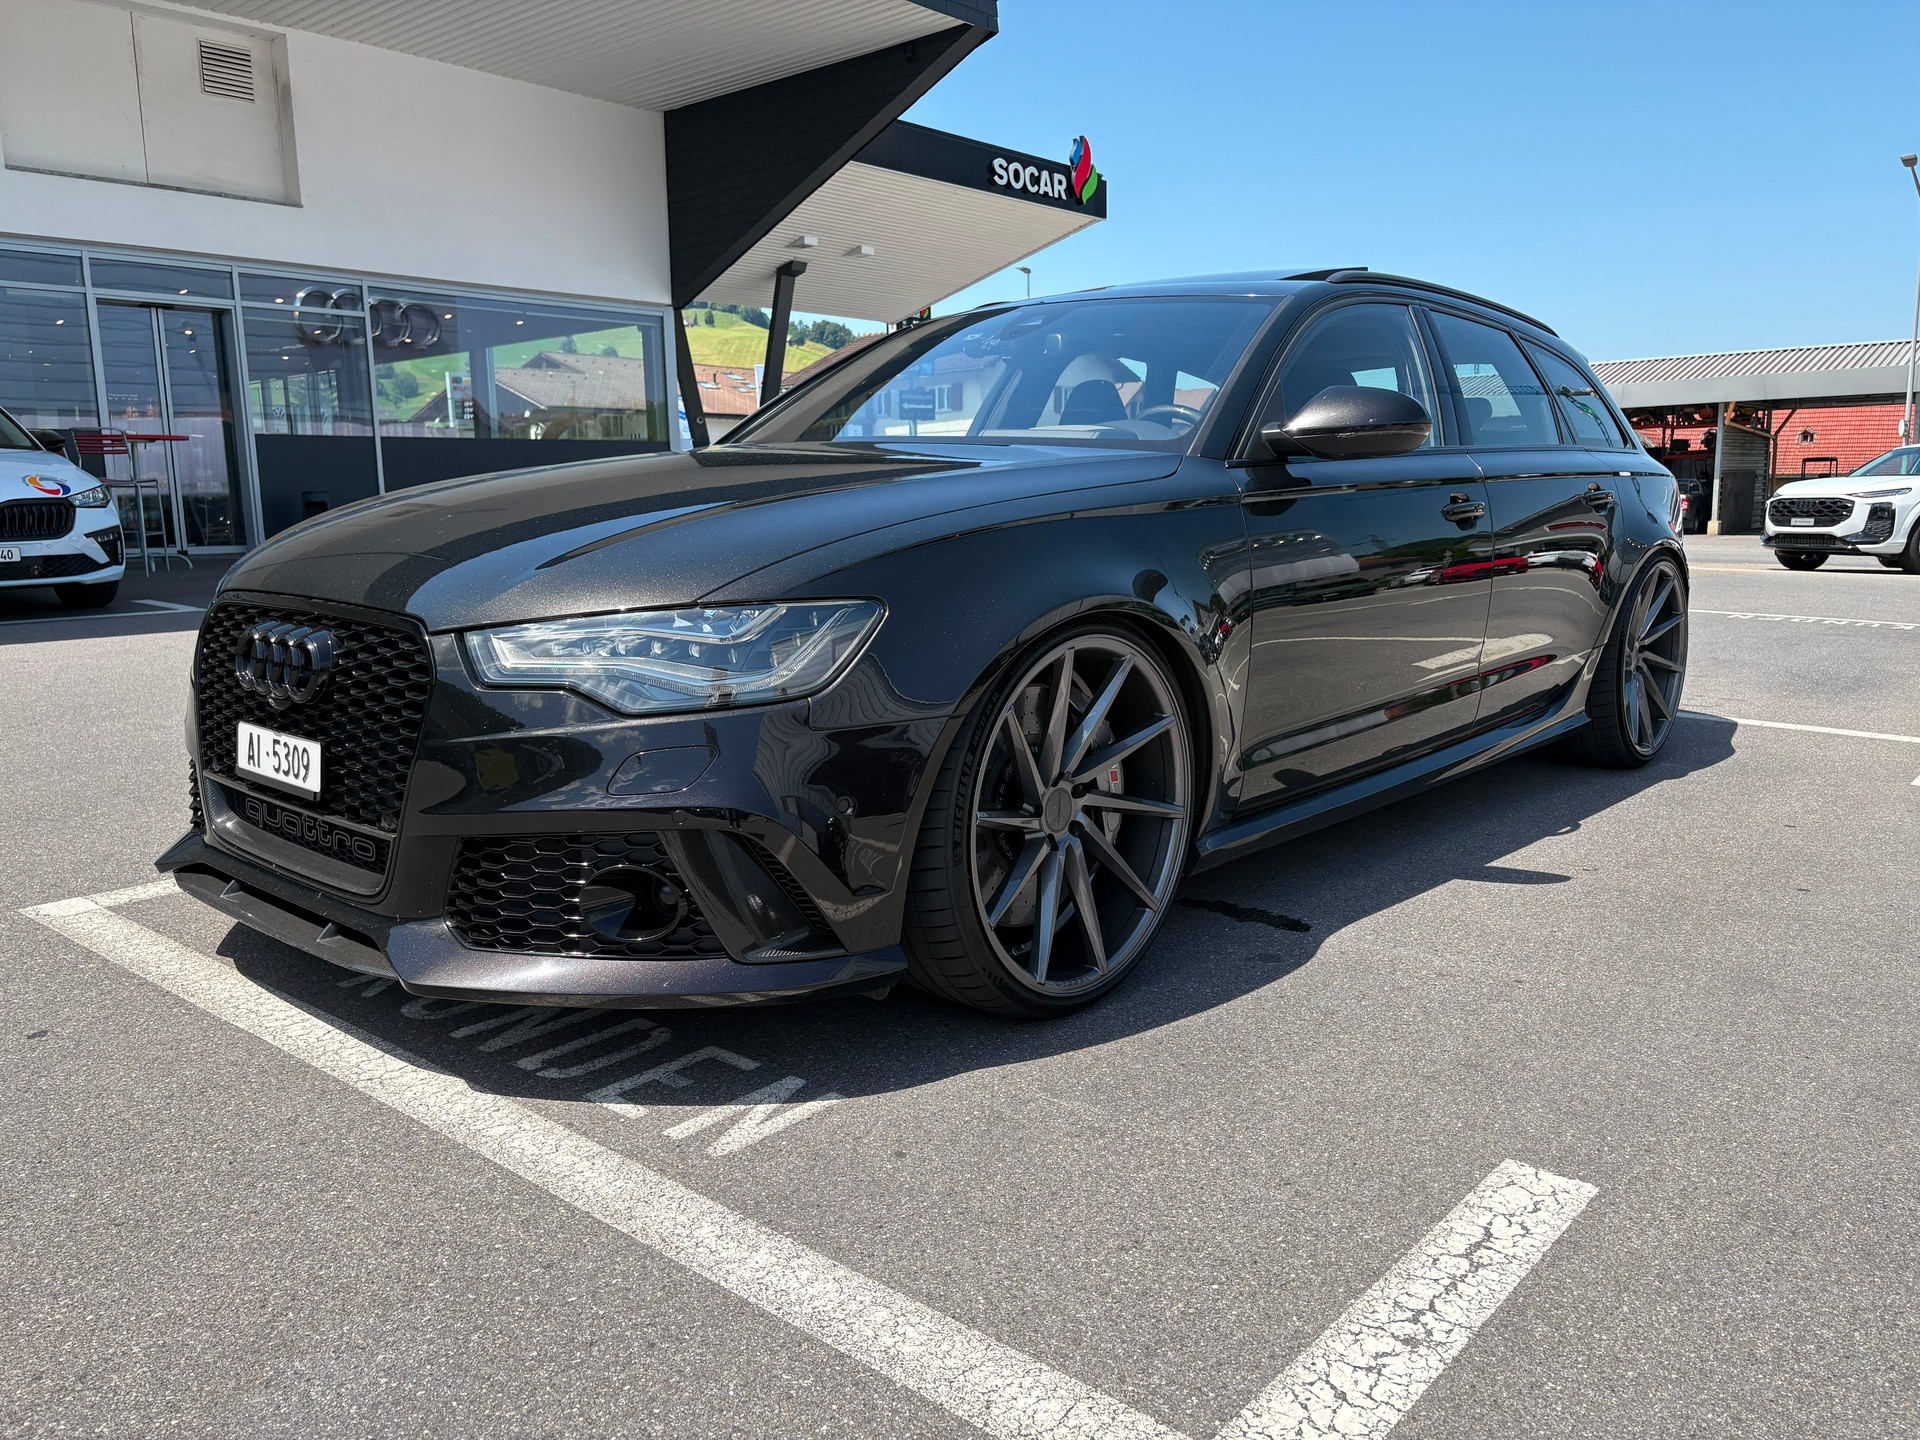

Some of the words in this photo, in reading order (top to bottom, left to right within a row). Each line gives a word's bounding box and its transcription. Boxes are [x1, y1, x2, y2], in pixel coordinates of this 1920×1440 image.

[992, 157, 1067, 200] SOCAR
[953, 752, 974, 843] MICHELIN
[246, 798, 376, 861] quattro
